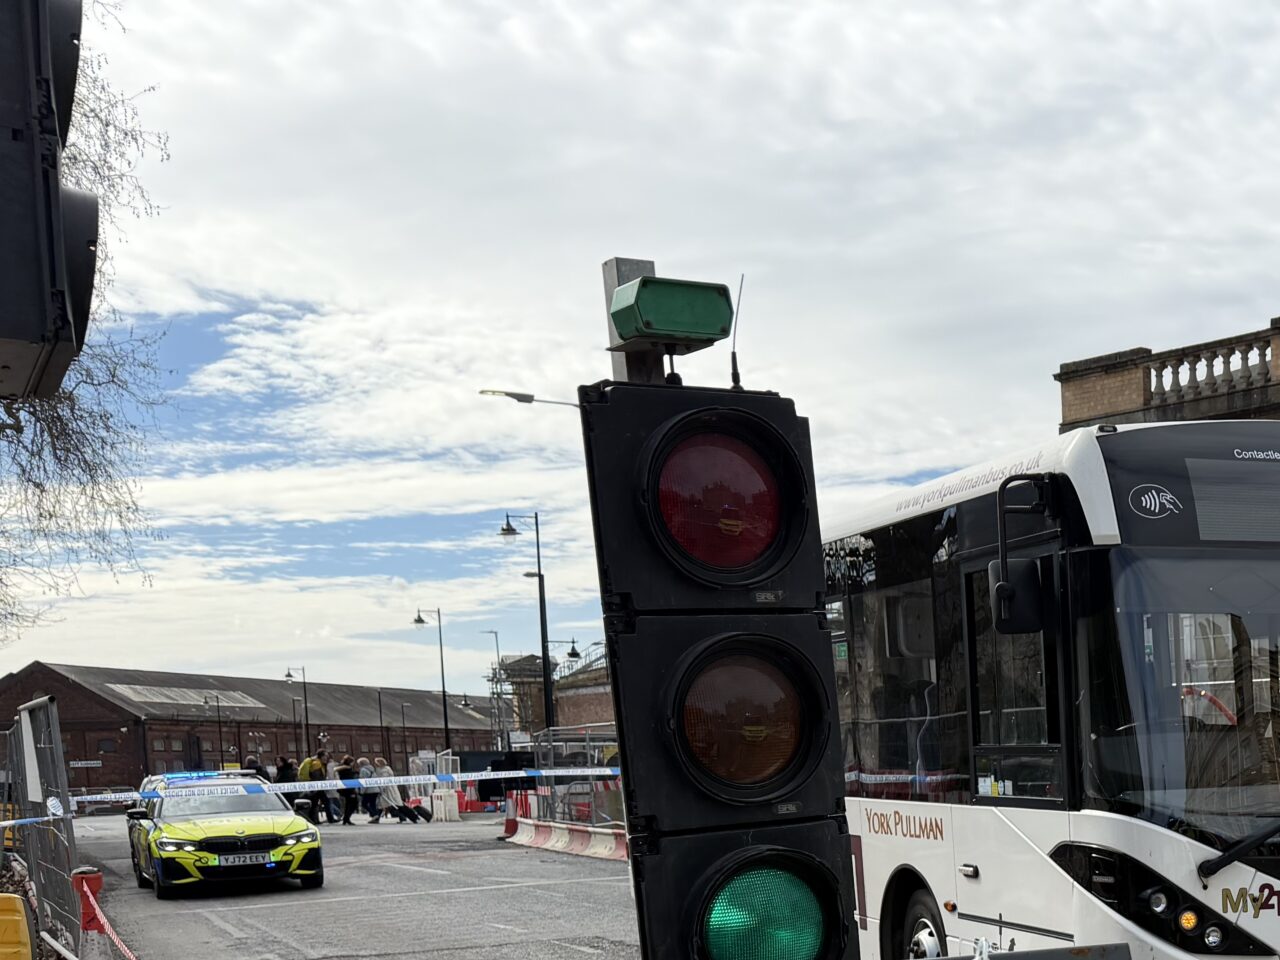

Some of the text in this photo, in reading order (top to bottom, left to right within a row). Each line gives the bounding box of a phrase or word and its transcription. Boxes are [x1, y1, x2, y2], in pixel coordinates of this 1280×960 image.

[184, 789, 196, 797] NOT
[864, 808, 944, 841] YORK PULLMAN
[222, 854, 268, 865] YJ72 EEY
